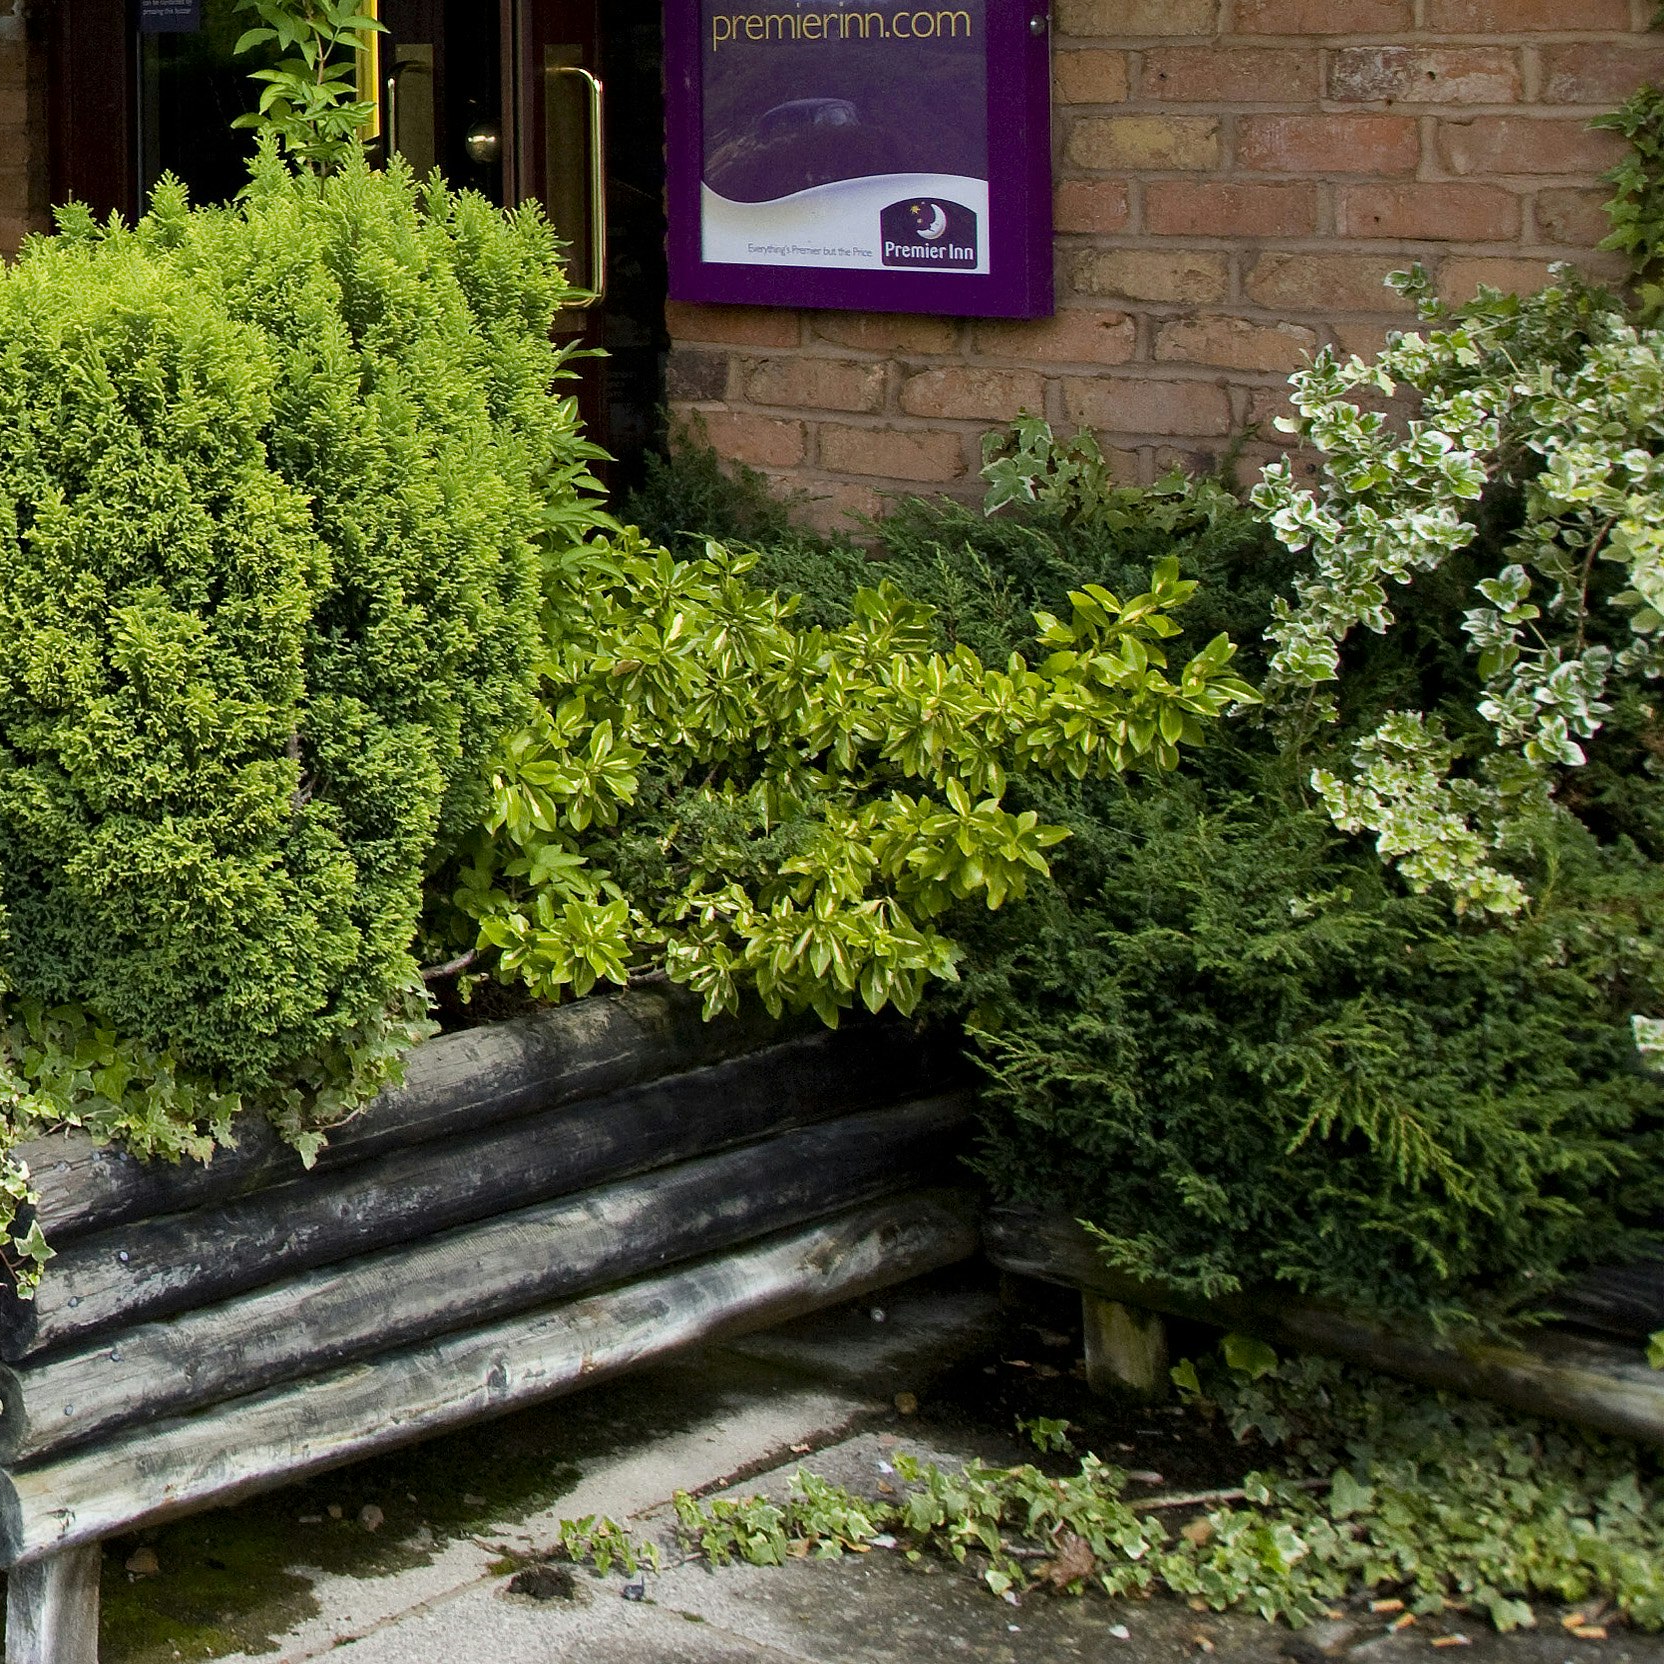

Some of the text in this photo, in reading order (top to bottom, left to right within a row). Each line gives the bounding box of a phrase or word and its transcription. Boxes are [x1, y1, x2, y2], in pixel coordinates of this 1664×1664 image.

[712, 1, 972, 52] premierinn.com
[747, 243, 873, 258] Everything's Premier but the Price
[885, 241, 974, 261] Premier Inn
